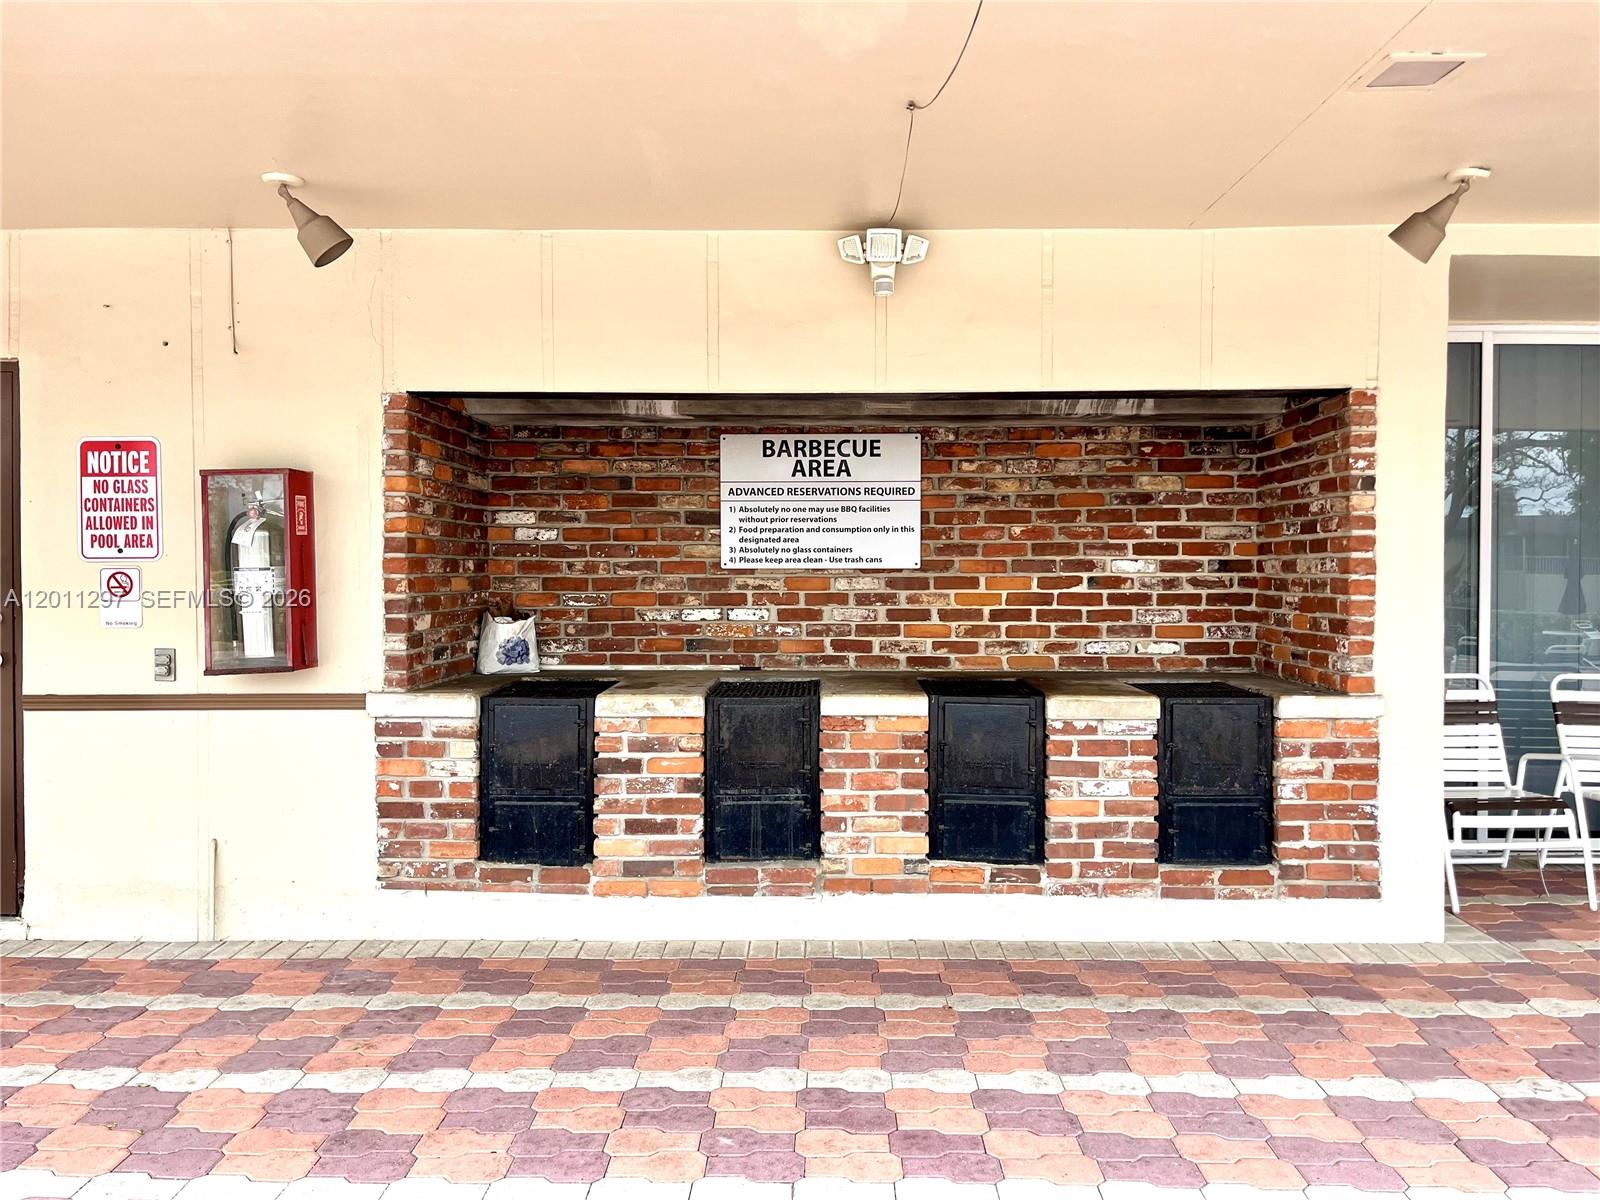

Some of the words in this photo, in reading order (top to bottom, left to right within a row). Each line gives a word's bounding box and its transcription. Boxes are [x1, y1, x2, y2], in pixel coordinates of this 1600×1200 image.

[762, 439, 881, 458] BARBECUE
[87, 451, 149, 474] NOTICE
[791, 459, 851, 477] AREA
[93, 480, 108, 494] NO
[113, 480, 148, 494] GLASS
[728, 487, 784, 496] ADVANCED
[787, 487, 862, 496] RESERVATIONS
[864, 486, 915, 496] REQUIRED
[84, 498, 154, 512] CONTAINERS
[739, 505, 779, 514] Absolutely
[86, 516, 137, 530] ALLOWED
[142, 516, 153, 530] IN
[770, 516, 788, 525] prior
[760, 526, 804, 535] preparation
[873, 526, 890, 534] only
[91, 534, 120, 548] POOL
[124, 534, 153, 548] AREA
[739, 536, 781, 545] designated
[739, 546, 779, 555] Absolutely
[792, 546, 811, 555] glass
[765, 556, 783, 565] keep
